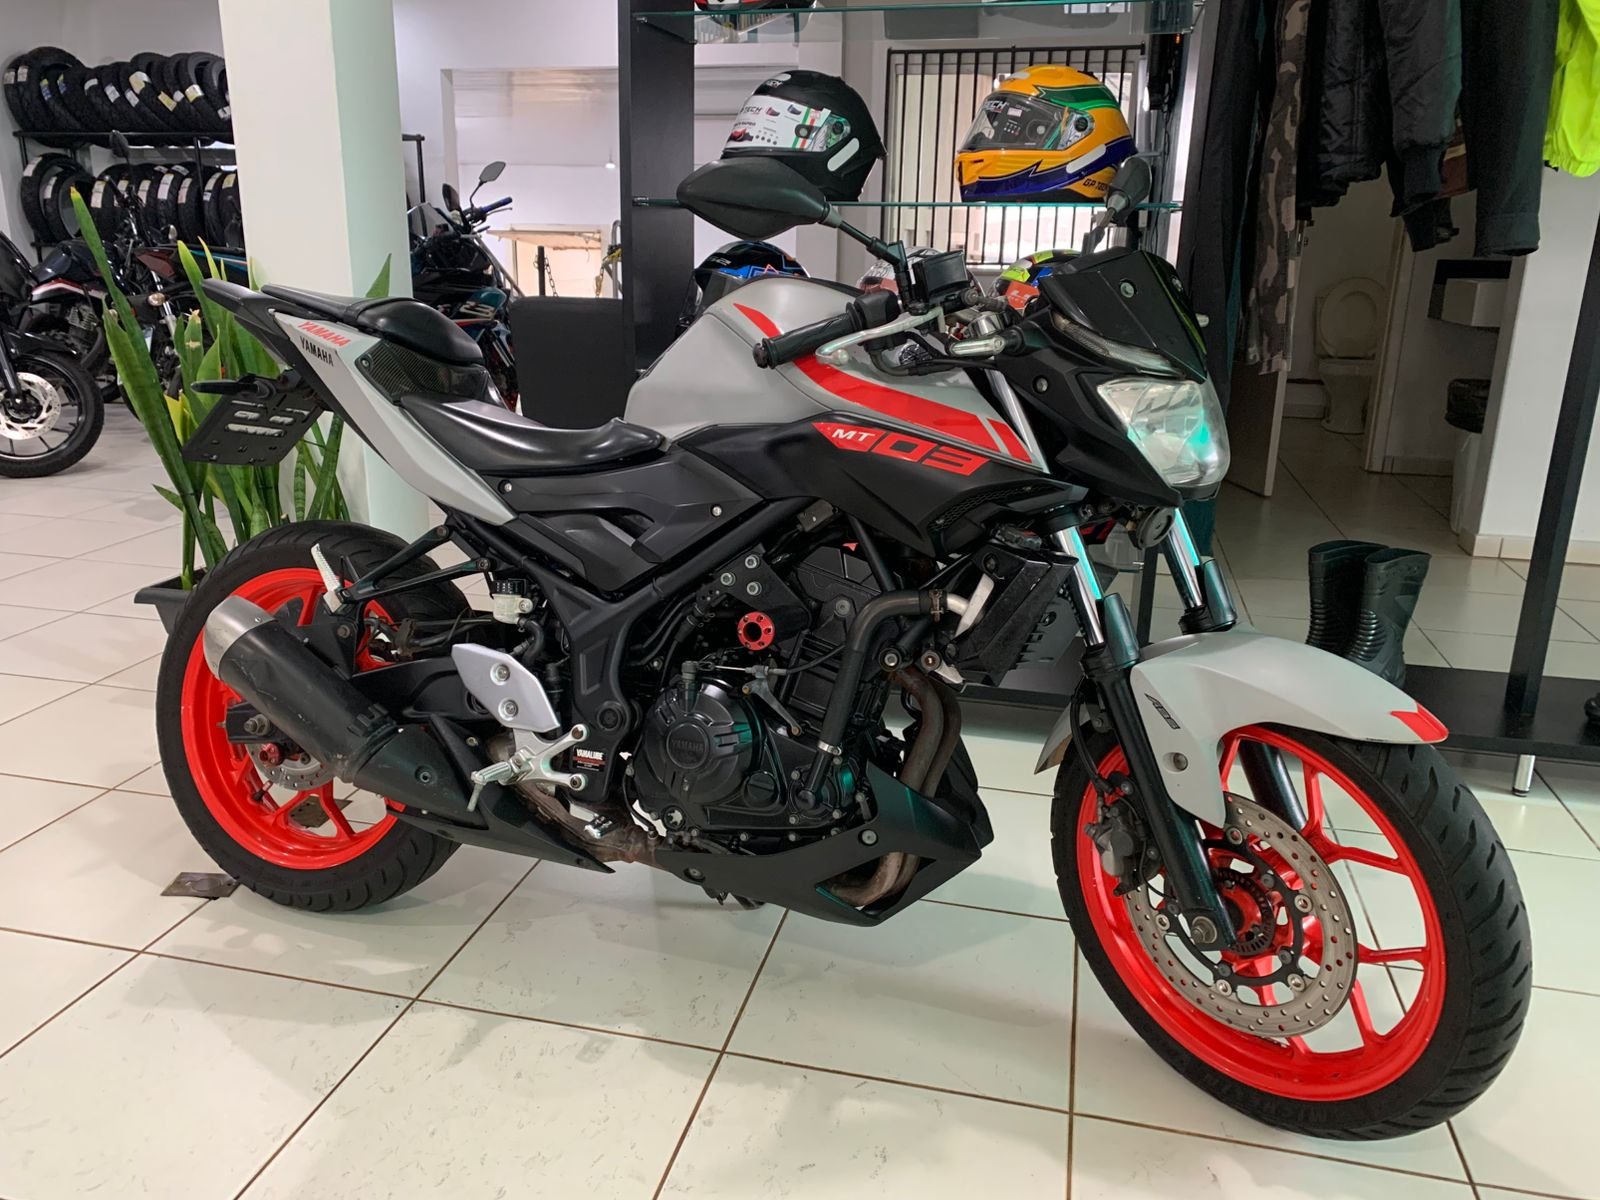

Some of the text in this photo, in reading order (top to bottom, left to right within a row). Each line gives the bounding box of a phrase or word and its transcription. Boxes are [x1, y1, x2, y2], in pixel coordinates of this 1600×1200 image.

[298, 321, 352, 347] YAMAHA
[300, 335, 334, 367] YAMAHA
[832, 428, 991, 477] MT 03
